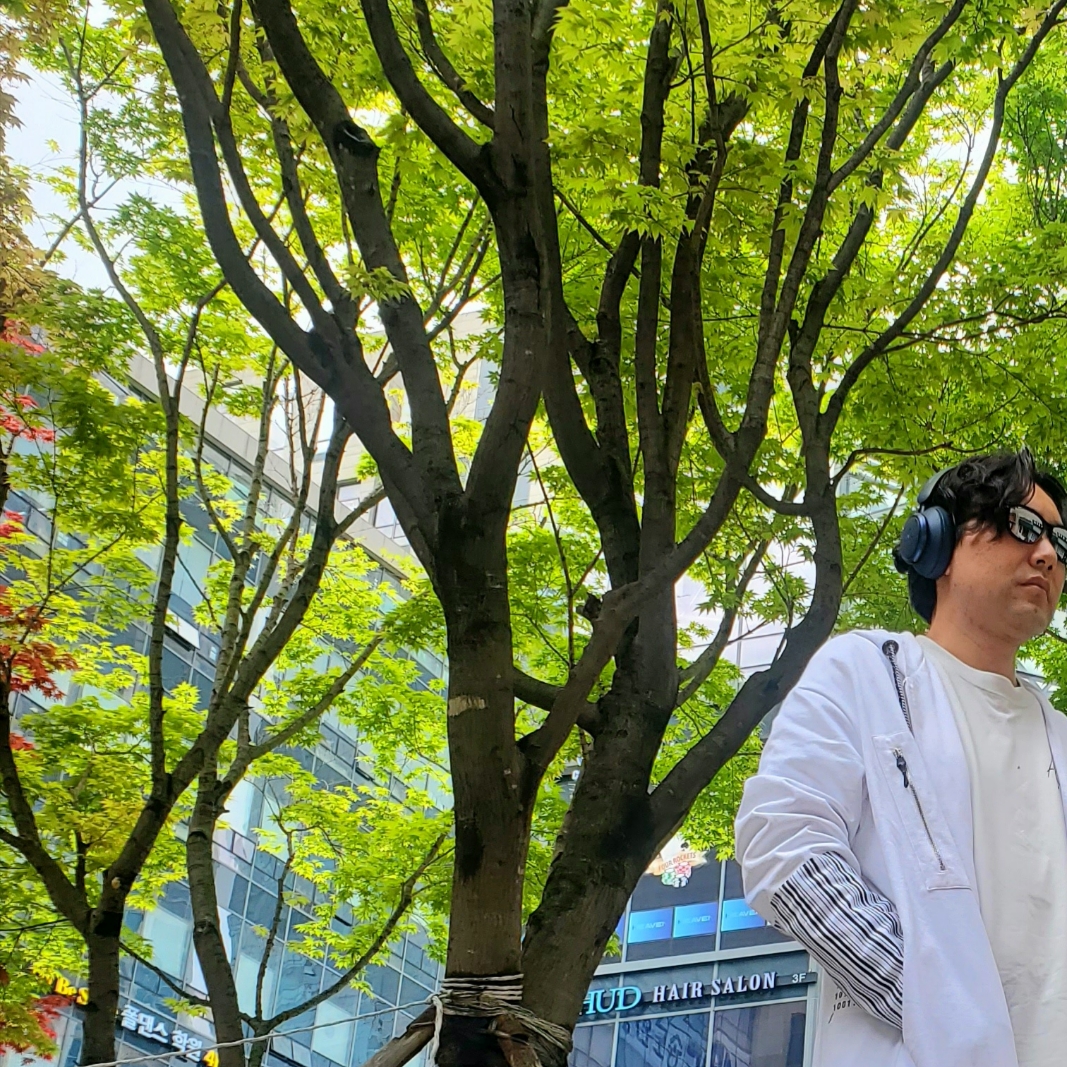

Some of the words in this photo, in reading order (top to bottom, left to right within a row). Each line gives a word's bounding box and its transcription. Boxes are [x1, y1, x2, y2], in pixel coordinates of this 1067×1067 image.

[652, 980, 705, 1003] HAIR
[711, 971, 777, 997] SALON
[792, 972, 807, 984] 3F
[171, 1029, 203, 1062] 학원
